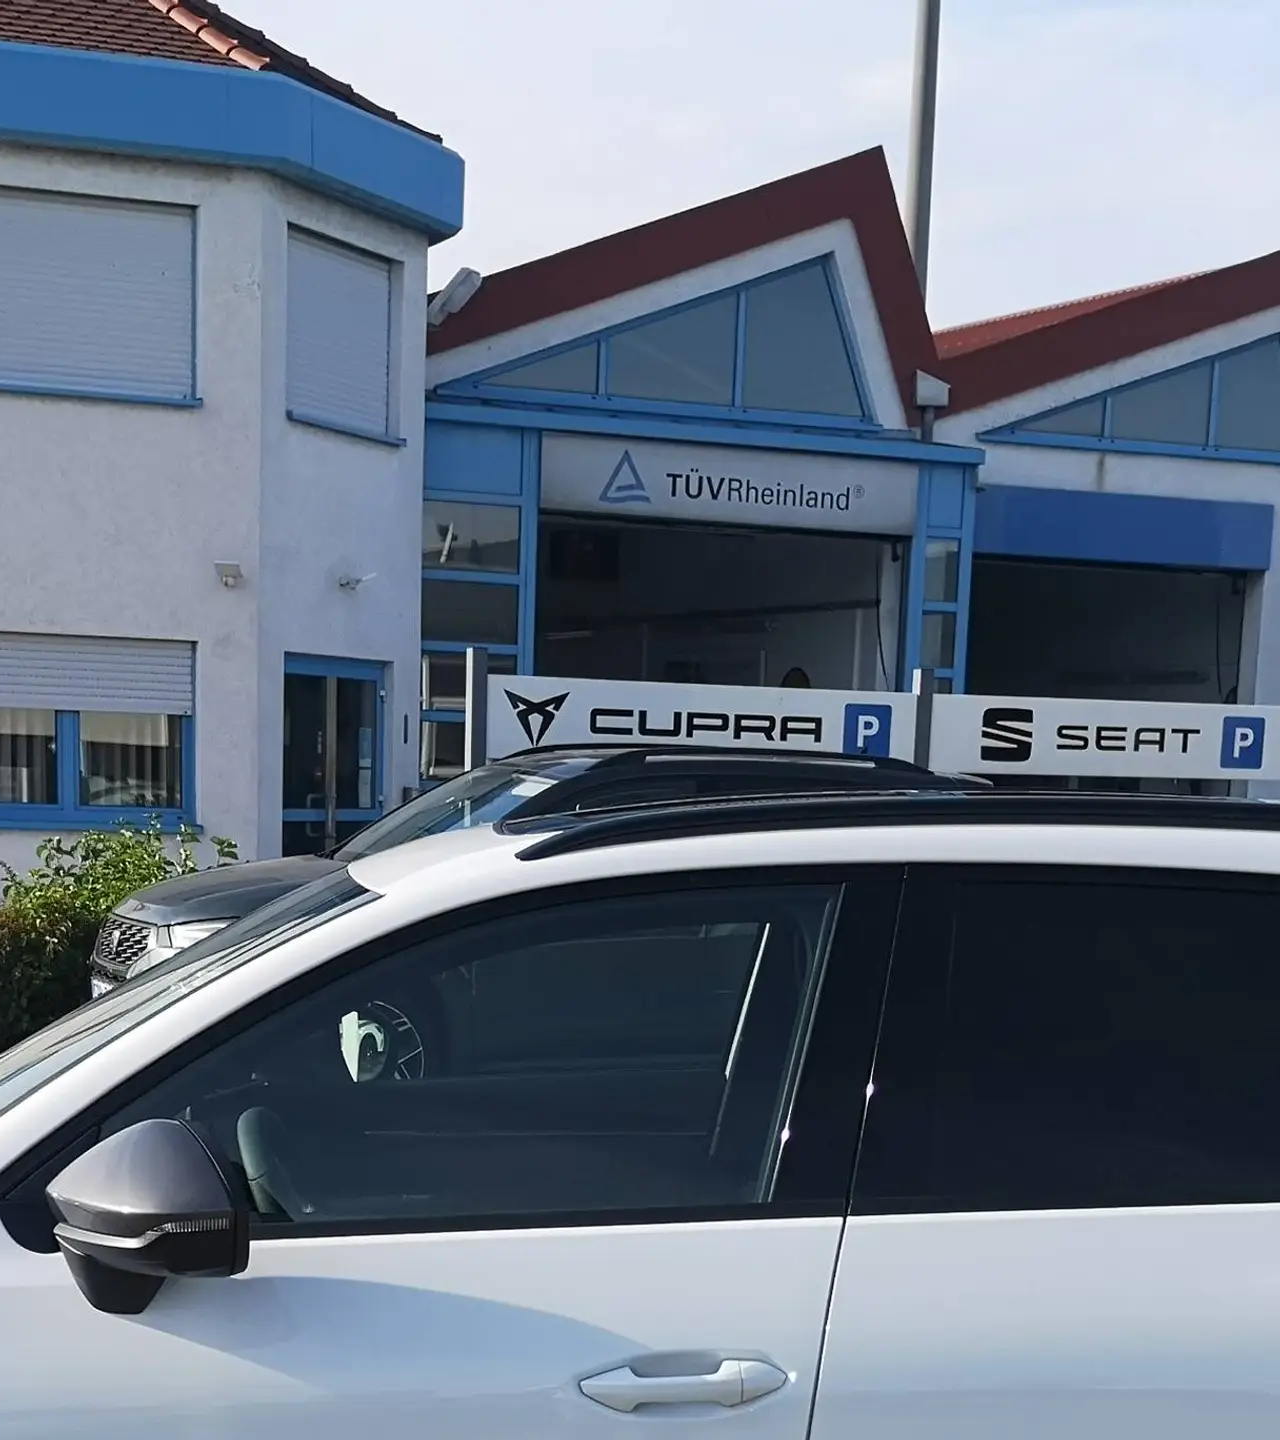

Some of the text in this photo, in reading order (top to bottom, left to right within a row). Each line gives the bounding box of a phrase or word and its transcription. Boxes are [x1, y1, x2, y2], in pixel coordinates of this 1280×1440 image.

[589, 707, 823, 743] CUPRA
[857, 716, 879, 748] P
[1055, 725, 1201, 754] SEAT
[1233, 727, 1254, 758] P
